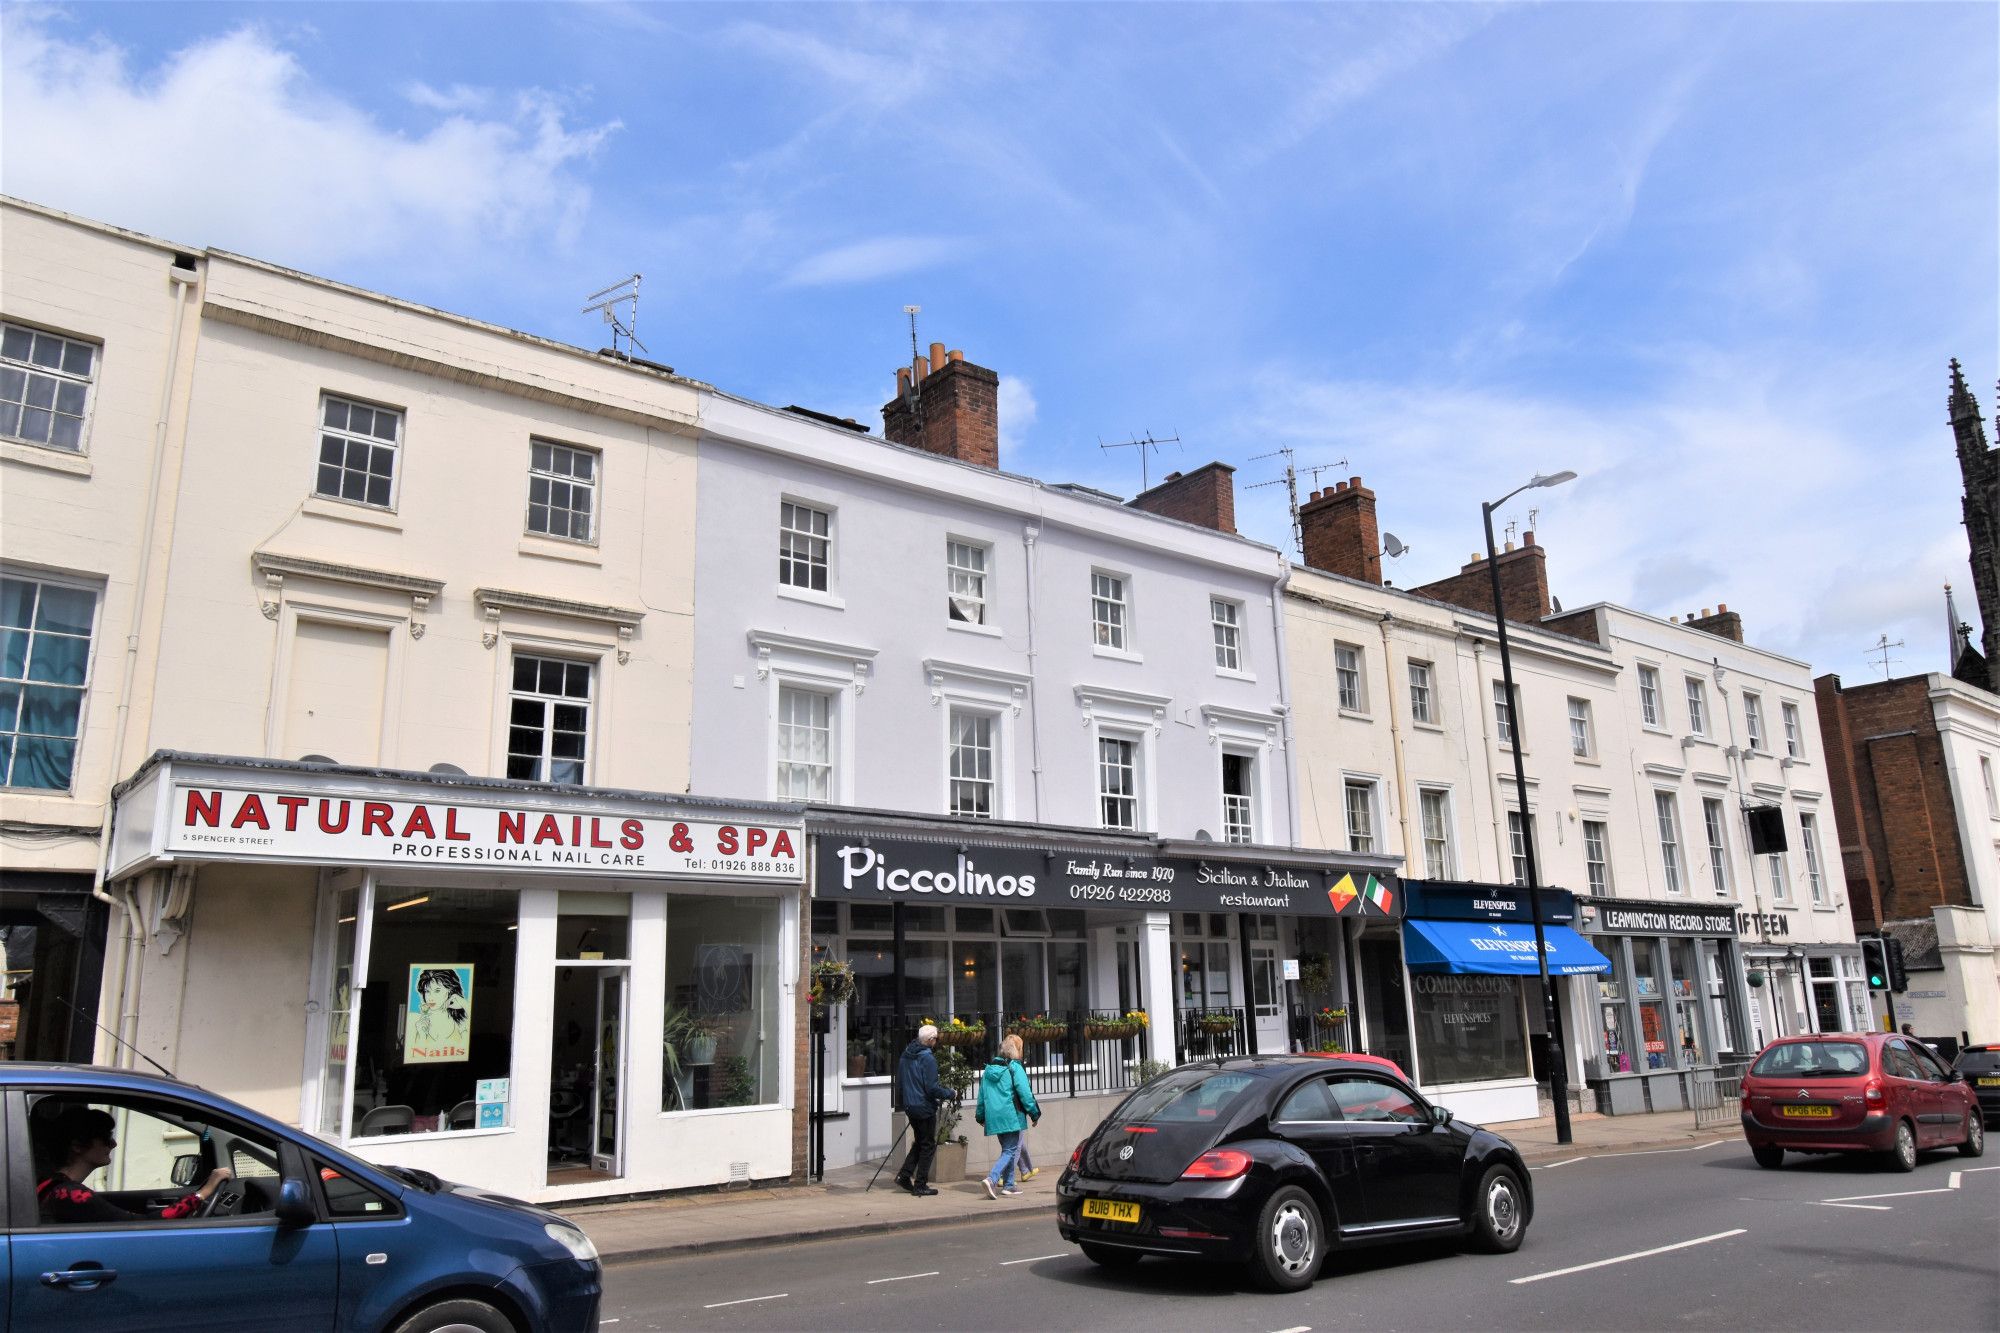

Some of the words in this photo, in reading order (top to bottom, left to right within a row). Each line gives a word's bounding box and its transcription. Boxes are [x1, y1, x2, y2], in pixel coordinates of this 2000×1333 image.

[184, 789, 472, 841] NATURAL
[497, 811, 645, 851] NAILS
[669, 822, 695, 854] &
[716, 825, 796, 859] SPA
[191, 834, 237, 844] SPENCER
[239, 836, 275, 846] STREET
[392, 842, 543, 862] PROFESSIONAL
[552, 851, 592, 864] NAIL
[601, 853, 645, 867] CARE
[685, 858, 707, 870] Tel:
[711, 860, 746, 872] 01926
[751, 861, 771, 873] 888
[775, 862, 795, 874] 836
[837, 844, 1036, 898] Piccolinos
[1066, 860, 1100, 880] Family
[1102, 863, 1123, 878] Run
[1125, 866, 1148, 879] since
[1151, 866, 1175, 883] 1979
[1196, 866, 1248, 887] Sicilian
[1250, 876, 1259, 887] &
[1264, 870, 1310, 890] Italian
[1070, 884, 1115, 901] 01926
[1118, 886, 1171, 903] 422988
[1220, 892, 1290, 909] restaurant
[1473, 899, 1516, 911] ELEVENSPICES
[1606, 911, 1667, 930] LEAMINGTON
[1669, 914, 1703, 931] RECORD
[1705, 915, 1733, 932] STORE
[1737, 912, 1789, 936] IFTEEN
[1416, 975, 1473, 994] COMING
[1476, 975, 1513, 993] SOON
[411, 1046, 465, 1058] Nails
[1088, 1200, 1110, 1215] BU18
[1112, 1202, 1133, 1218] THX
